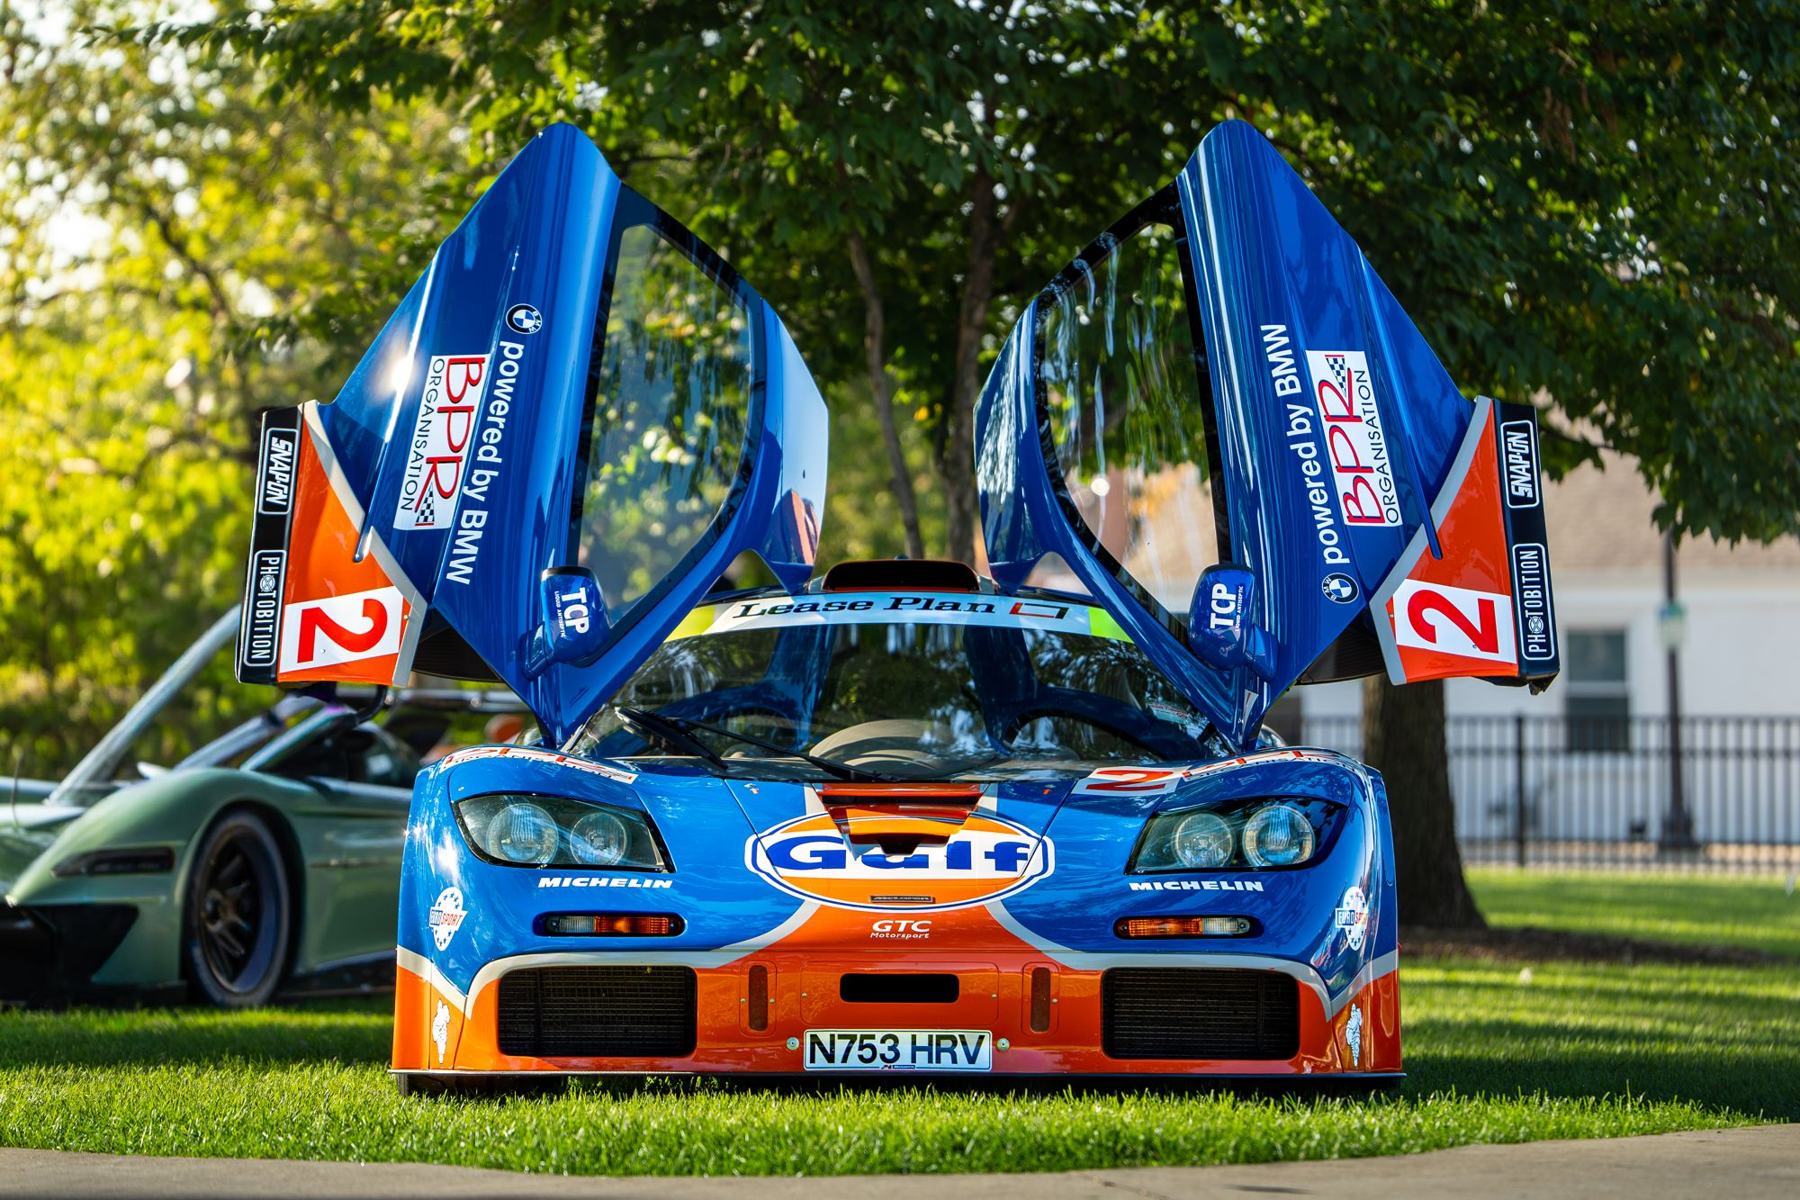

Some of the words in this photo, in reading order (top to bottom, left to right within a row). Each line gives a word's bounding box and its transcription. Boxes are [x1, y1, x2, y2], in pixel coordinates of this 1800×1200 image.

[1260, 324, 1303, 398] BMW
[477, 340, 524, 465] powered
[1286, 403, 1314, 438] by
[400, 358, 445, 512] ORGANISATION
[414, 356, 486, 513] BPR
[1317, 367, 1386, 524] BPR
[1353, 369, 1401, 524] ORGANISATION
[462, 470, 499, 503] by
[1291, 444, 1350, 565] powered
[446, 510, 488, 585] BMW
[561, 586, 590, 634] TCP
[732, 600, 875, 619] Lease
[882, 596, 996, 614] Plan
[1210, 583, 1237, 629] TCP
[1407, 589, 1500, 654] 2
[296, 598, 388, 664] 2
[1086, 770, 1174, 790] 2
[767, 835, 1031, 870] Gulf
[538, 877, 673, 889] MICHELIN
[1128, 880, 1265, 892] MICHELIN
[869, 932, 930, 940] Motorsport
[872, 919, 932, 933] GTC
[808, 1034, 901, 1065] N753
[911, 1034, 986, 1065] HRV
